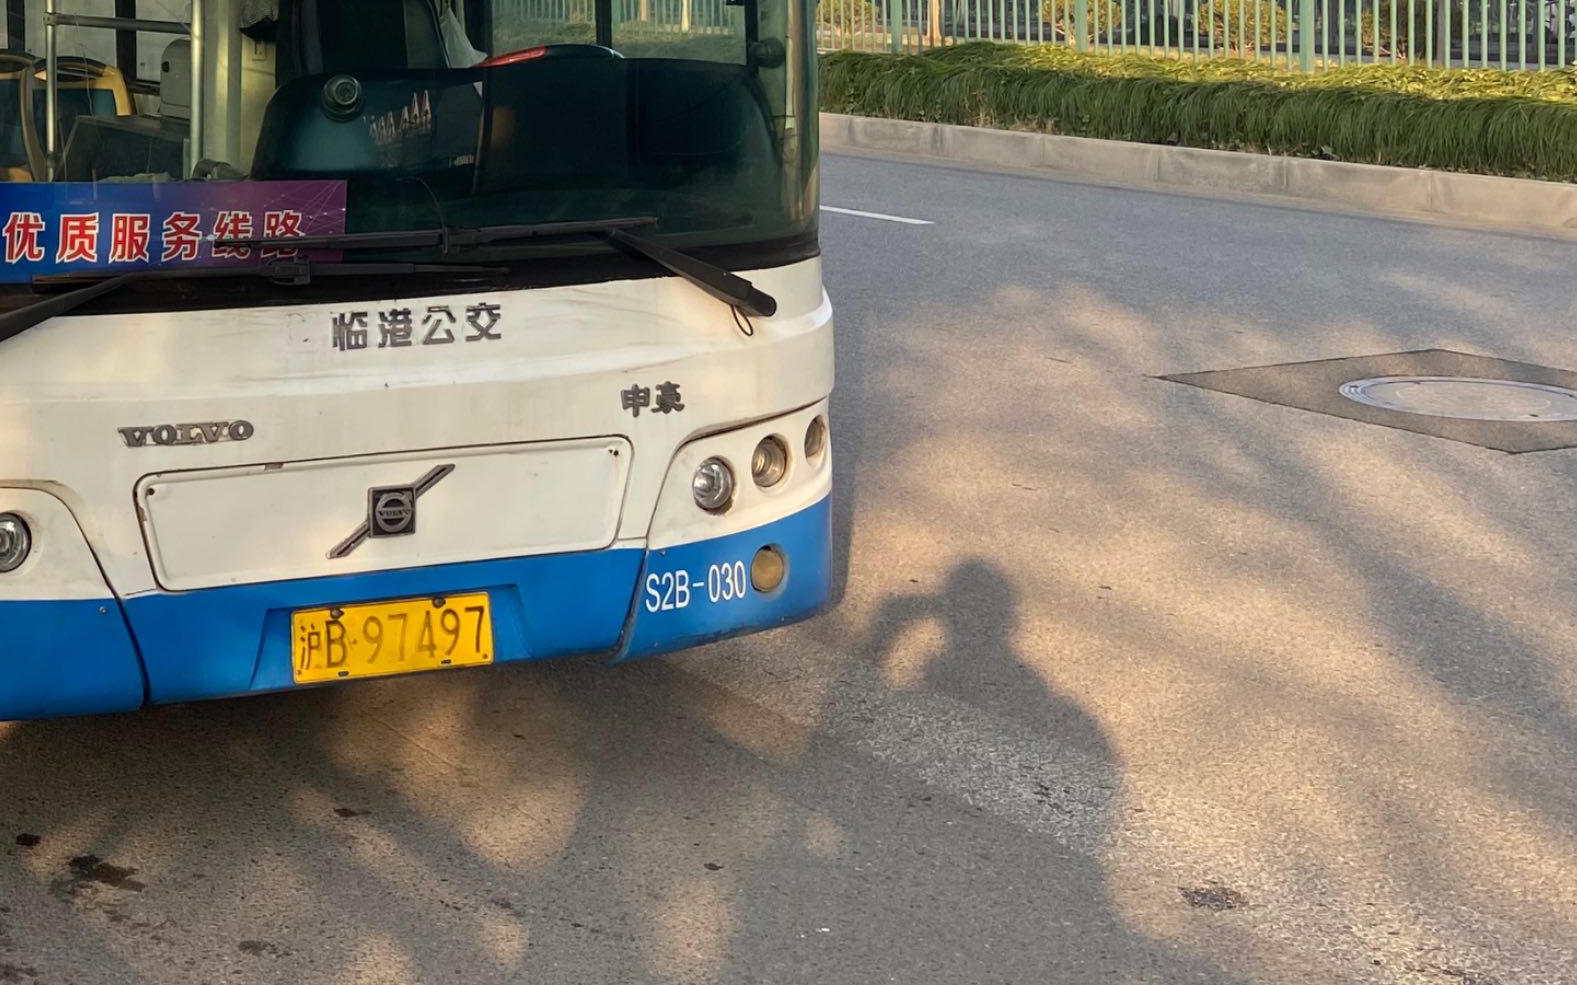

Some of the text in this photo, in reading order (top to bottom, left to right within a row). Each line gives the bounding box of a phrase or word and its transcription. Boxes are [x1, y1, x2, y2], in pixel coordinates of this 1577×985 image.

[331, 303, 502, 352] 临港公交
[118, 419, 255, 448] VOLVO
[645, 560, 747, 613] S2B-030
